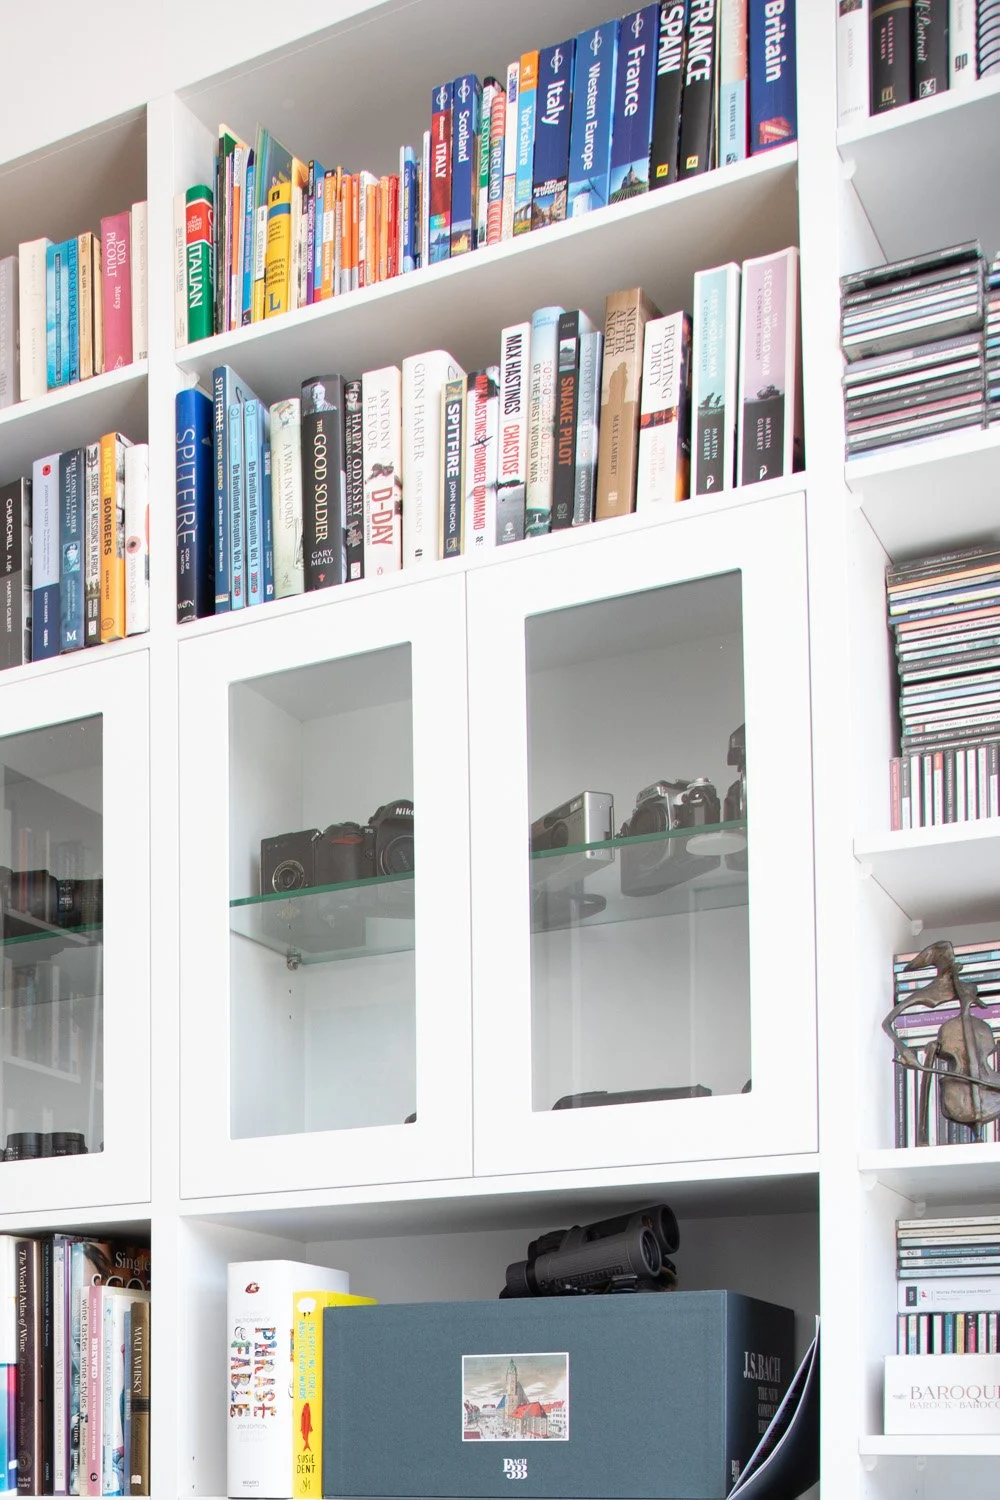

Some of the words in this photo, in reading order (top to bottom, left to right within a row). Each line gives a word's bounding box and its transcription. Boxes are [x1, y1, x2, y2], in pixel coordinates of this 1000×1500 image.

[657, 6, 684, 76] SPAIN
[765, 0, 787, 83] Britain
[541, 80, 565, 125] Italy
[585, 62, 600, 121] Western
[624, 44, 645, 117] France
[435, 142, 447, 178] ITALY
[458, 110, 470, 163] Scotland
[519, 106, 532, 166] Yorkshire
[580, 122, 597, 170] Europe
[489, 145, 501, 199] IRELAND
[107, 232, 117, 277] PICOULT
[117, 240, 126, 265] JODI
[189, 243, 203, 308] ITALIAN
[113, 286, 121, 310] Mercy
[507, 333, 522, 360] MAX
[605, 311, 615, 357] NIGHT
[615, 310, 626, 355] AFTER
[626, 307, 636, 352] NIGHT
[650, 343, 661, 387] DIRTY
[661, 324, 675, 399] FIGHTING
[505, 362, 521, 416] HASTINGS
[560, 376, 574, 423] SNAKE
[368, 396, 378, 451] BEEVOR
[381, 389, 390, 451] ANTONY
[446, 403, 460, 478] SPITFIRE
[757, 418, 765, 451] GILBERT
[315, 434, 326, 481] GOOD
[503, 424, 520, 475] CHASTISE
[558, 427, 573, 466] PILOT
[610, 437, 619, 477] LAMBERT
[176, 427, 195, 544] SPITFIRE
[5, 498, 13, 551] CHURCHILL
[315, 484, 327, 543] SOLDIER
[372, 487, 393, 546] D-DAY
[311, 550, 332, 559] GARY
[311, 557, 334, 567] MEAD
[133, 1326, 142, 1358] MALT
[133, 1361, 142, 1394] WHISKY
[230, 1340, 252, 1419] FABLE
[254, 1327, 277, 1419] PHRASE
[296, 1464, 316, 1474] DENT
